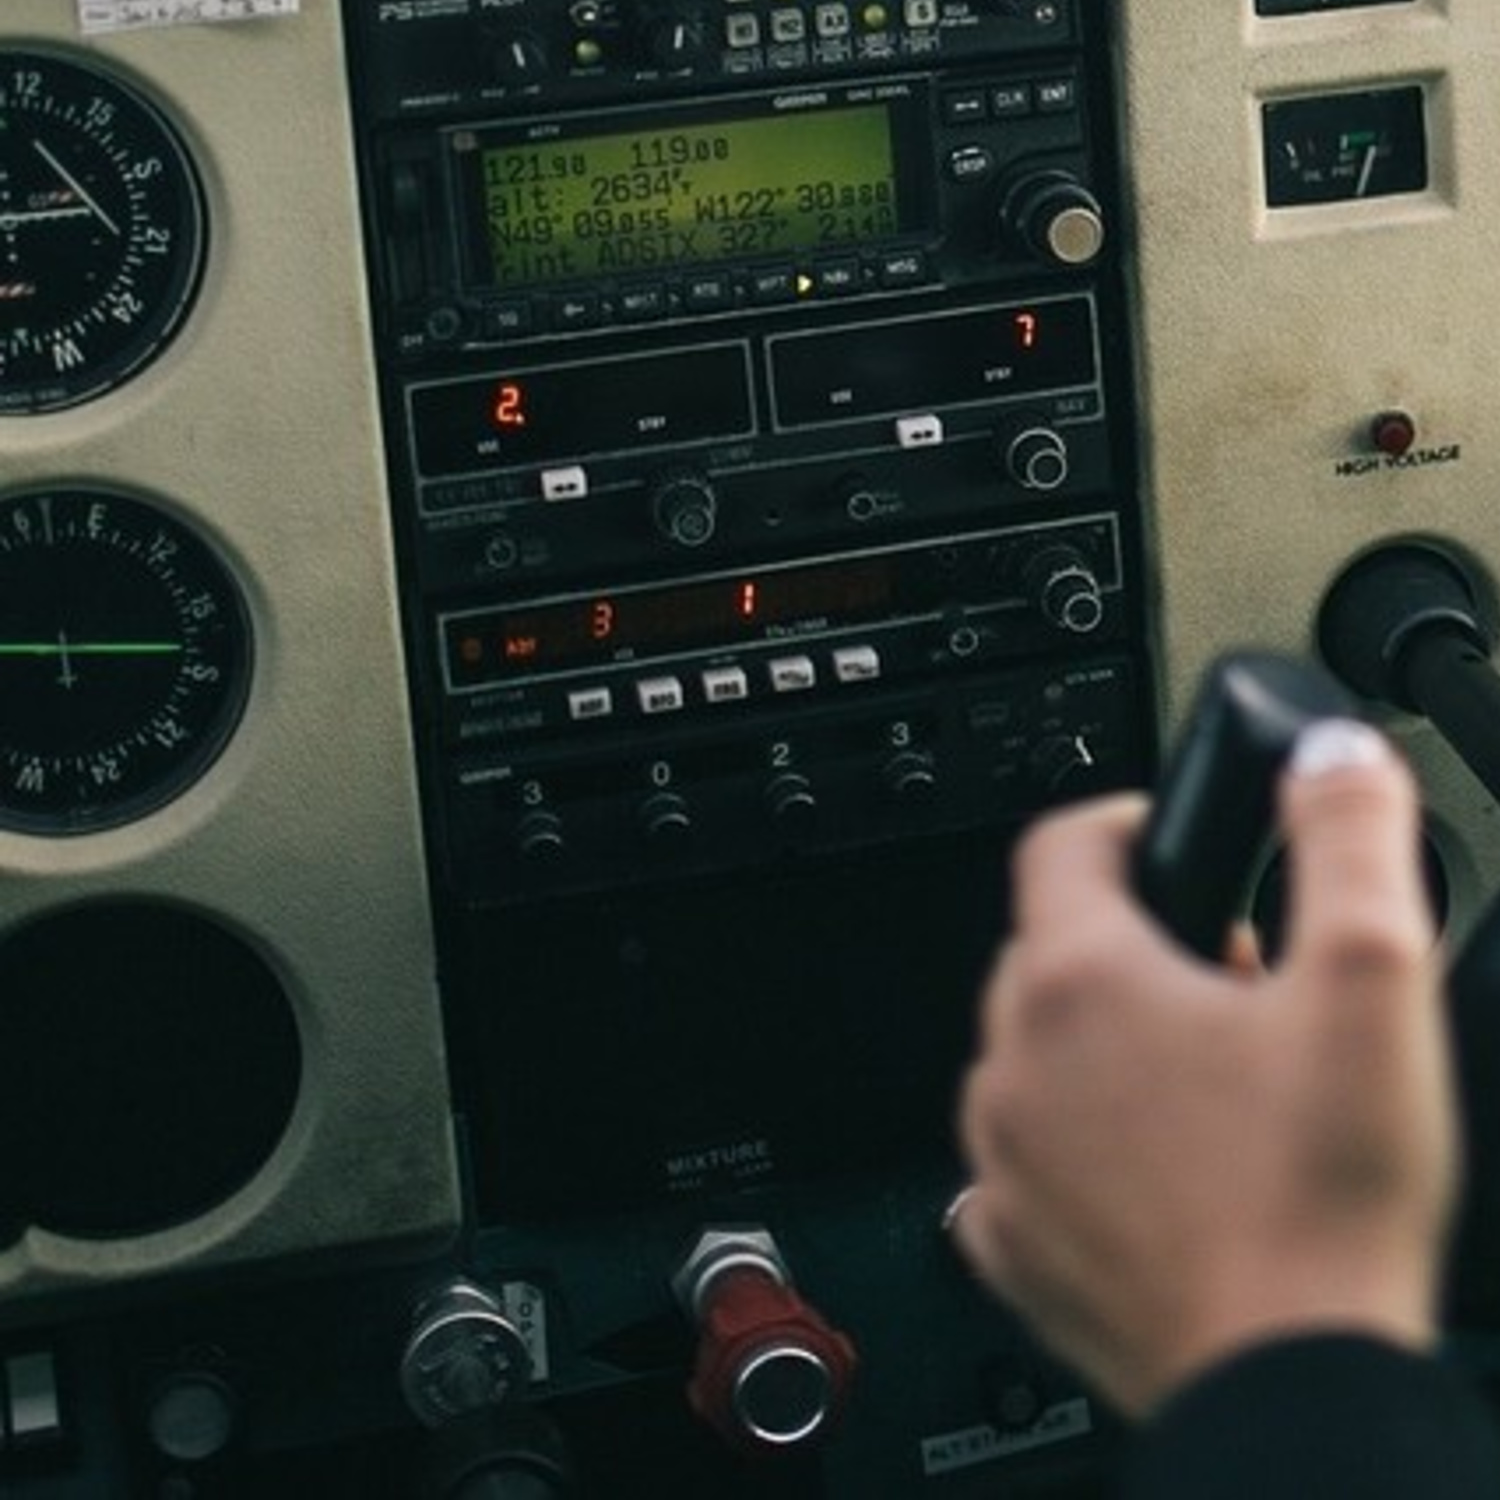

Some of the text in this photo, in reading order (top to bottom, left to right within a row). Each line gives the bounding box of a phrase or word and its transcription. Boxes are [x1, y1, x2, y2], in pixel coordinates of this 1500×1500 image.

[14, 70, 42, 97] 12
[86, 96, 115, 127] 15
[133, 157, 163, 180] S
[52, 338, 85, 372] W
[1335, 444, 1461, 477] HIGH VOLTAGE
[87, 503, 108, 532] E
[149, 531, 178, 563] 12
[189, 592, 217, 619] 15
[593, 600, 615, 639] 3
[190, 663, 219, 684] S
[523, 721, 911, 805] 3 0 2 3
[15, 764, 44, 794] W
[666, 1138, 770, 1176] MIXTURE
